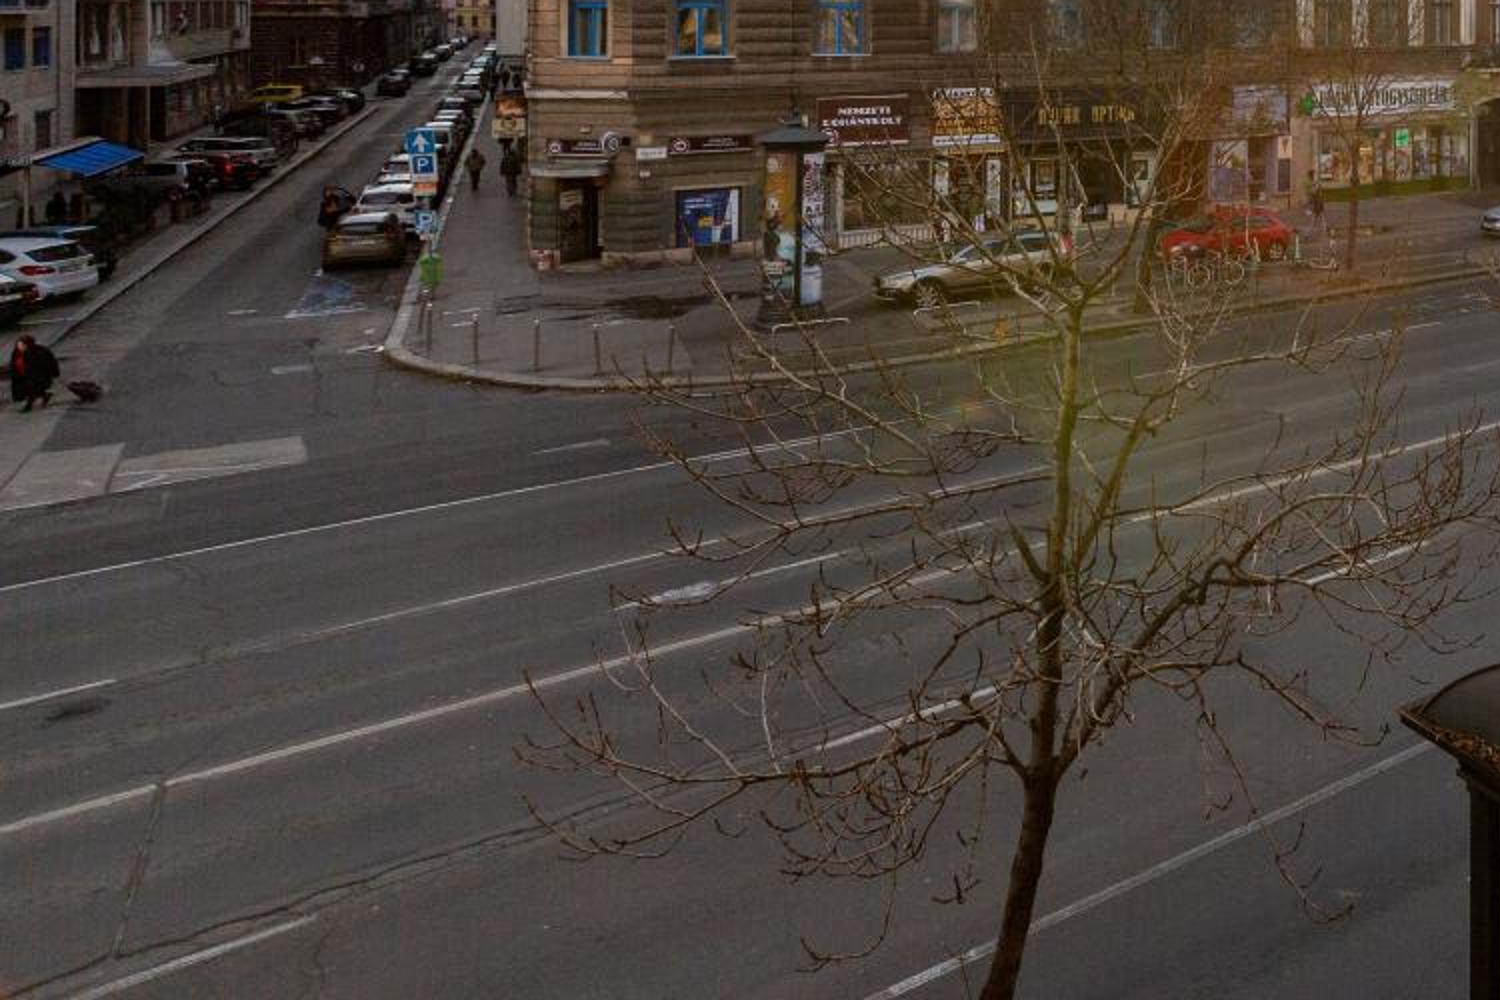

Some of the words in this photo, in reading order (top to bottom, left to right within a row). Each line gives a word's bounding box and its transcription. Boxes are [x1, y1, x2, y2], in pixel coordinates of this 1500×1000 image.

[836, 105, 892, 116] NEMZETI
[417, 157, 430, 174] P
[418, 213, 433, 232] P
